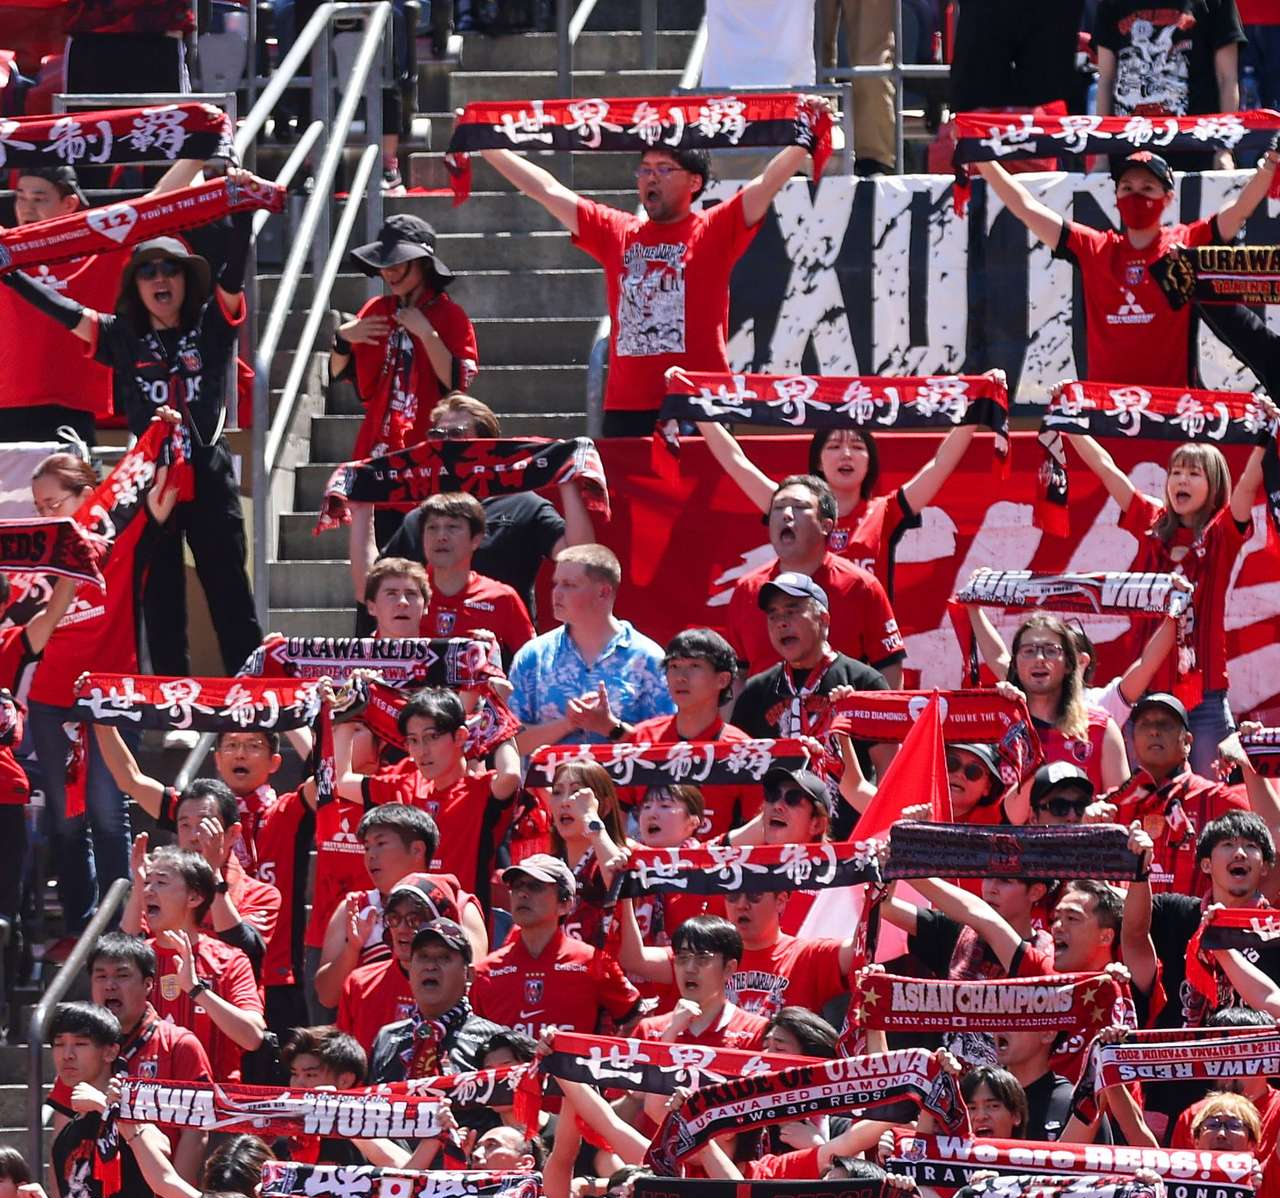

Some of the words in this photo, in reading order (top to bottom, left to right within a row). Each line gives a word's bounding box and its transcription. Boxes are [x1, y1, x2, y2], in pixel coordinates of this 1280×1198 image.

[495, 98, 751, 147] 世界制覇
[981, 115, 1249, 156] 世界制覇
[100, 213, 130, 230] 12
[688, 376, 973, 427] 世界制覇
[375, 467, 449, 481] URAWA
[475, 458, 549, 473] REDS
[287, 638, 367, 660] URAWA
[374, 639, 431, 661] REDS
[892, 983, 952, 1012] ASIAN
[955, 985, 1073, 1012] CHAMPIONS
[828, 1049, 927, 1080] URAWA
[1120, 1063, 1197, 1079] REDS
[697, 1103, 761, 1128] URAWA
[772, 1085, 811, 1105] RED
[820, 1074, 926, 1099] DIAMONDS
